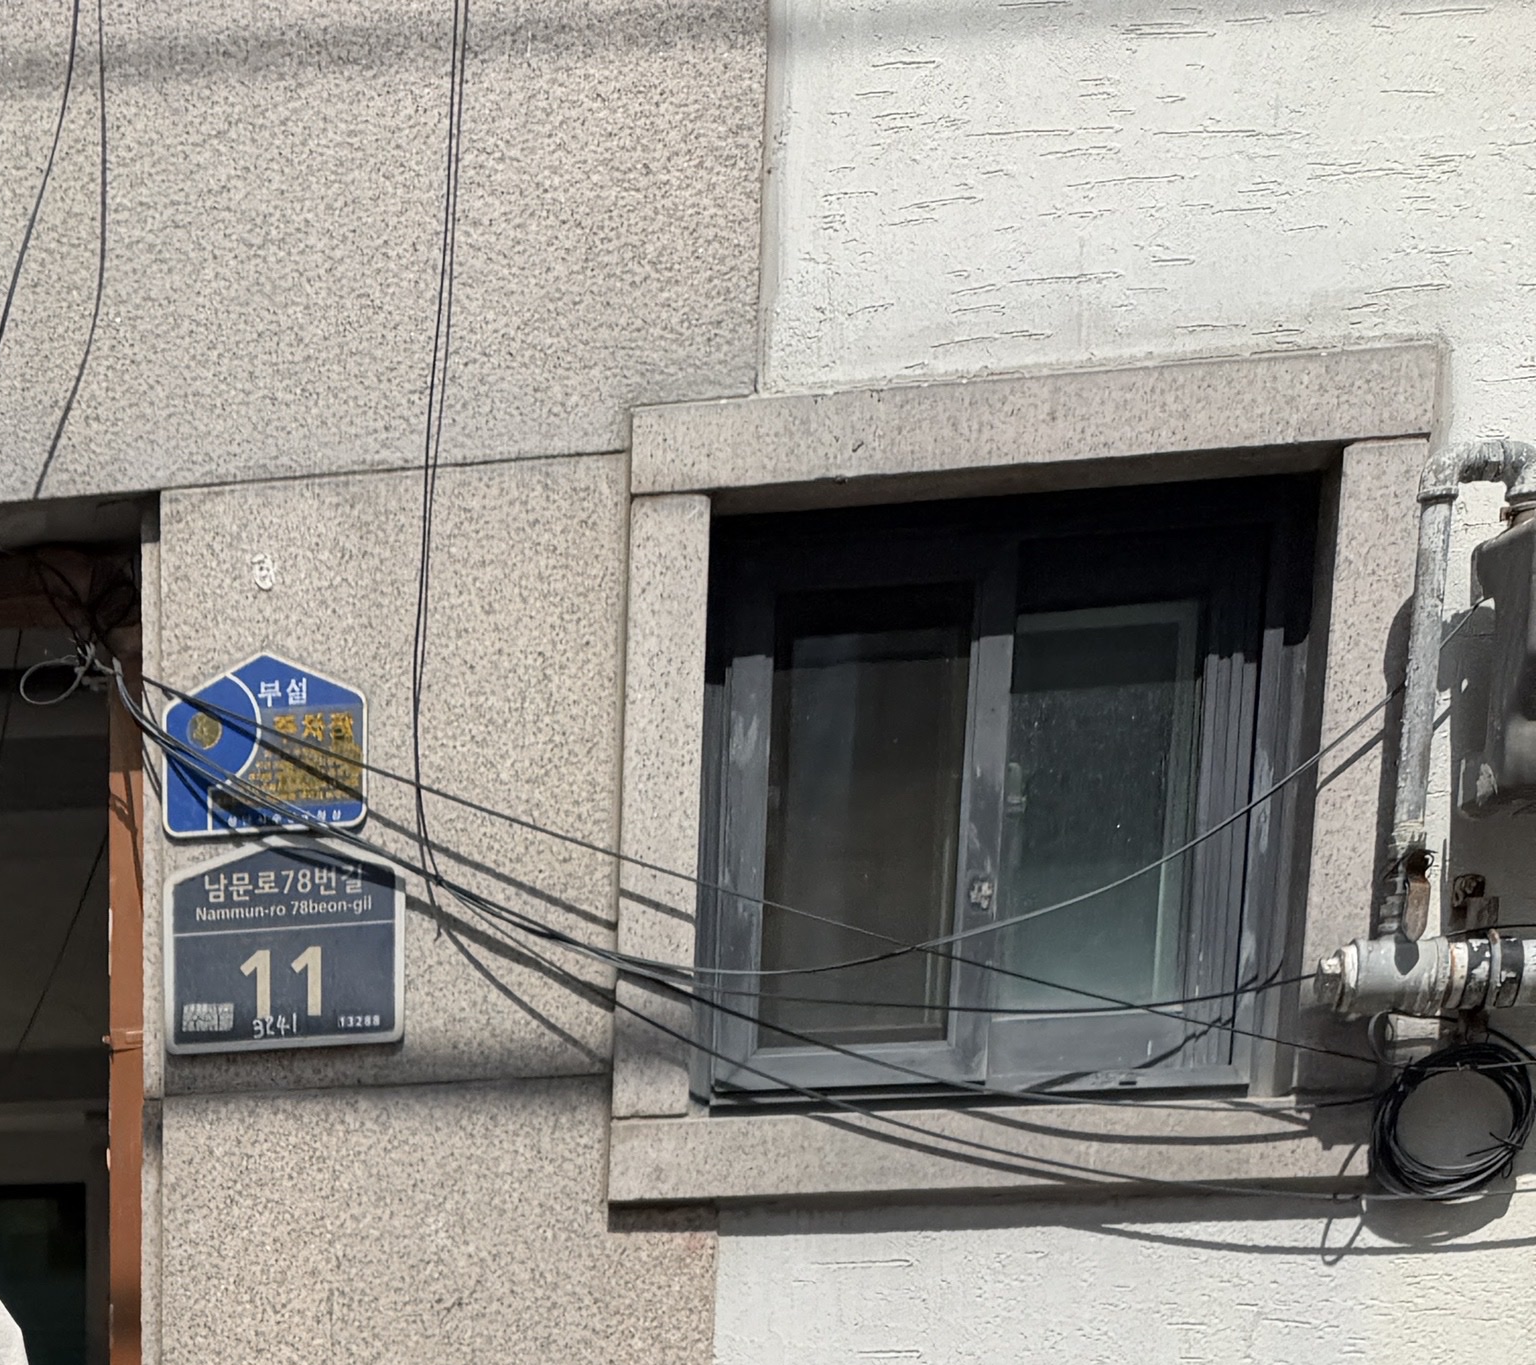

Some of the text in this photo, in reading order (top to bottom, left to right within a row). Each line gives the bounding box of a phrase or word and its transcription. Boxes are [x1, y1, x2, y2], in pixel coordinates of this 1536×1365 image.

[257, 677, 308, 708] 부설
[203, 863, 363, 903] 남문로78번길
[195, 894, 372, 922] Nammun-ro 78beon-gil
[239, 946, 322, 1019] 11
